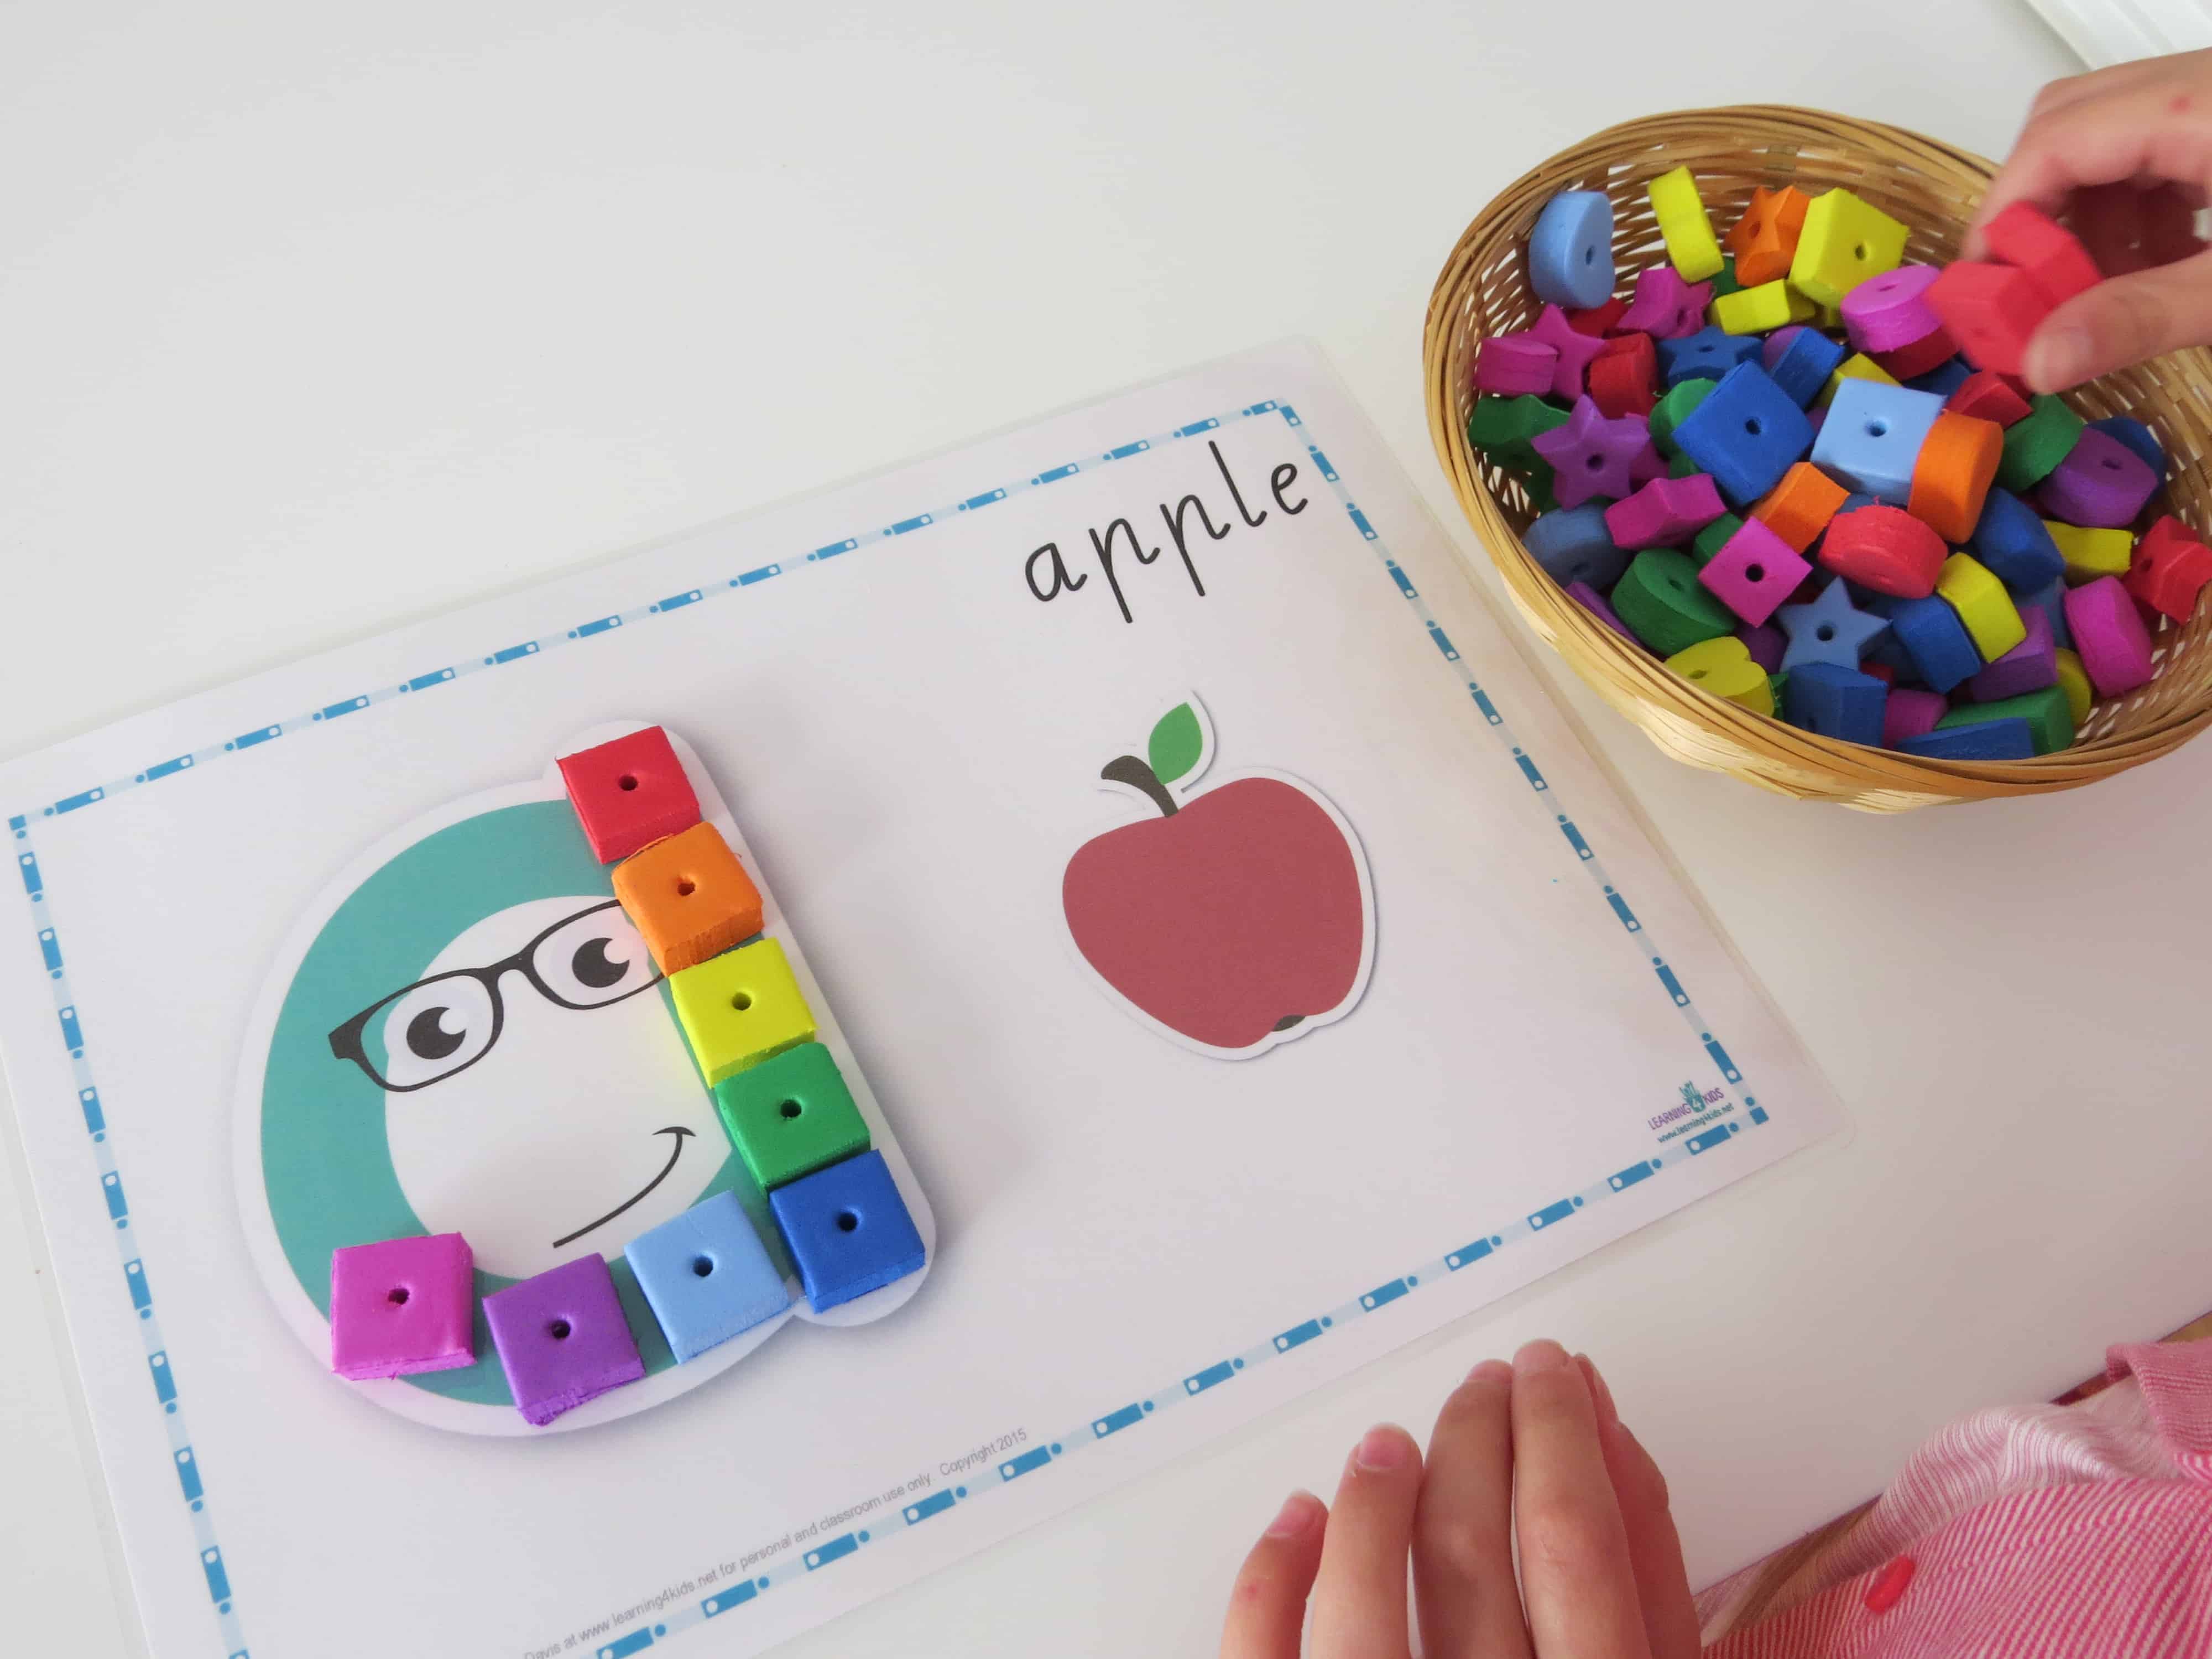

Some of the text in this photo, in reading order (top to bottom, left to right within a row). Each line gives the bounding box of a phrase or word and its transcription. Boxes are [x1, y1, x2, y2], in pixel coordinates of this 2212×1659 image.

[1025, 440, 1308, 624] apple
[1647, 1103, 1692, 1130] LEARNING
[1703, 1087, 1724, 1105] KIDS
[563, 1633, 577, 1649] at
[719, 1561, 737, 1577] for
[739, 1533, 792, 1572] personal
[794, 1521, 818, 1543] and
[819, 1496, 881, 1531] classroom
[881, 1485, 905, 1503] use
[940, 1442, 997, 1476] Copyright
[996, 1427, 1027, 1452] 2015
